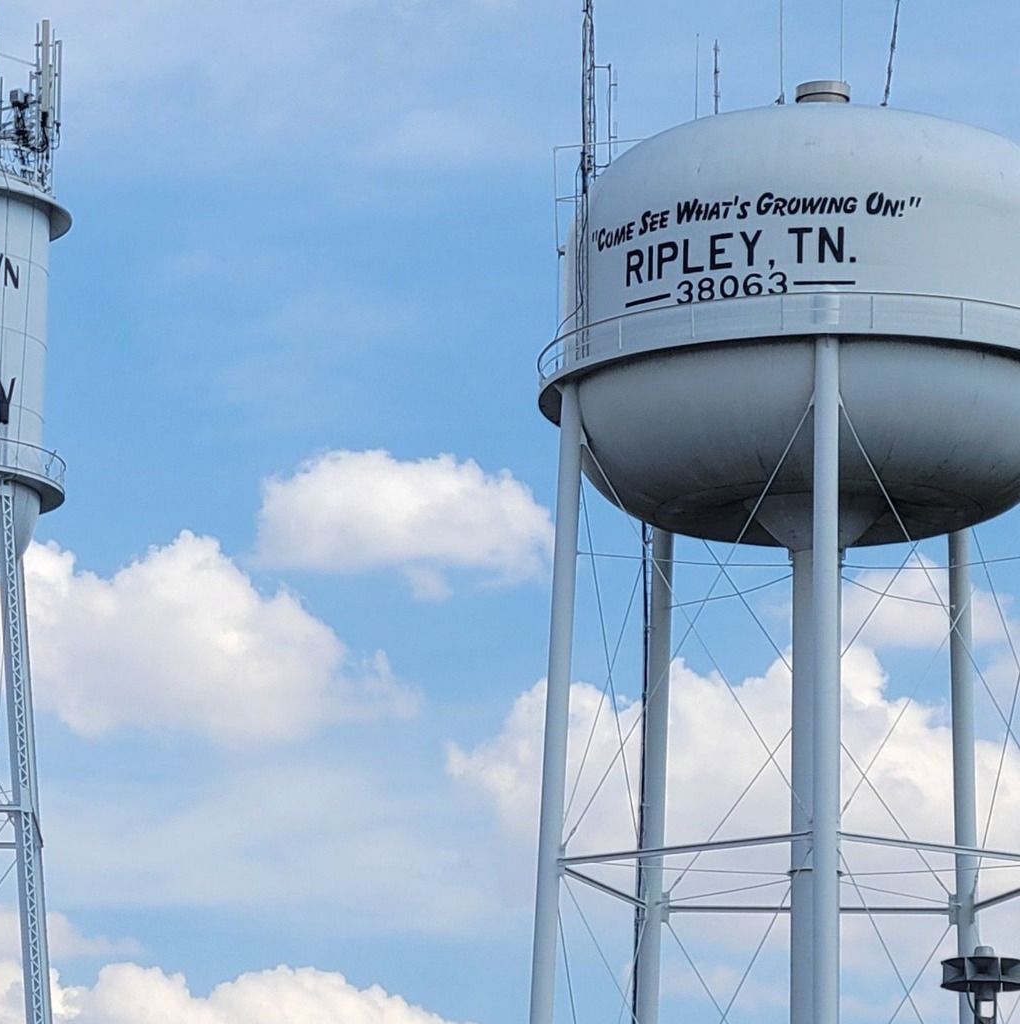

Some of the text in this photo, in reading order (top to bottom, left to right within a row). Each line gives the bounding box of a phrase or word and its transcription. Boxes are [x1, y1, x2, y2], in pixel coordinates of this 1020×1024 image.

[639, 210, 670, 236] SEE
[677, 195, 751, 225] WHAT'S
[756, 192, 858, 216] GROWING
[626, 226, 856, 287] RIPLEY, TN.
[676, 271, 787, 305] 38063
